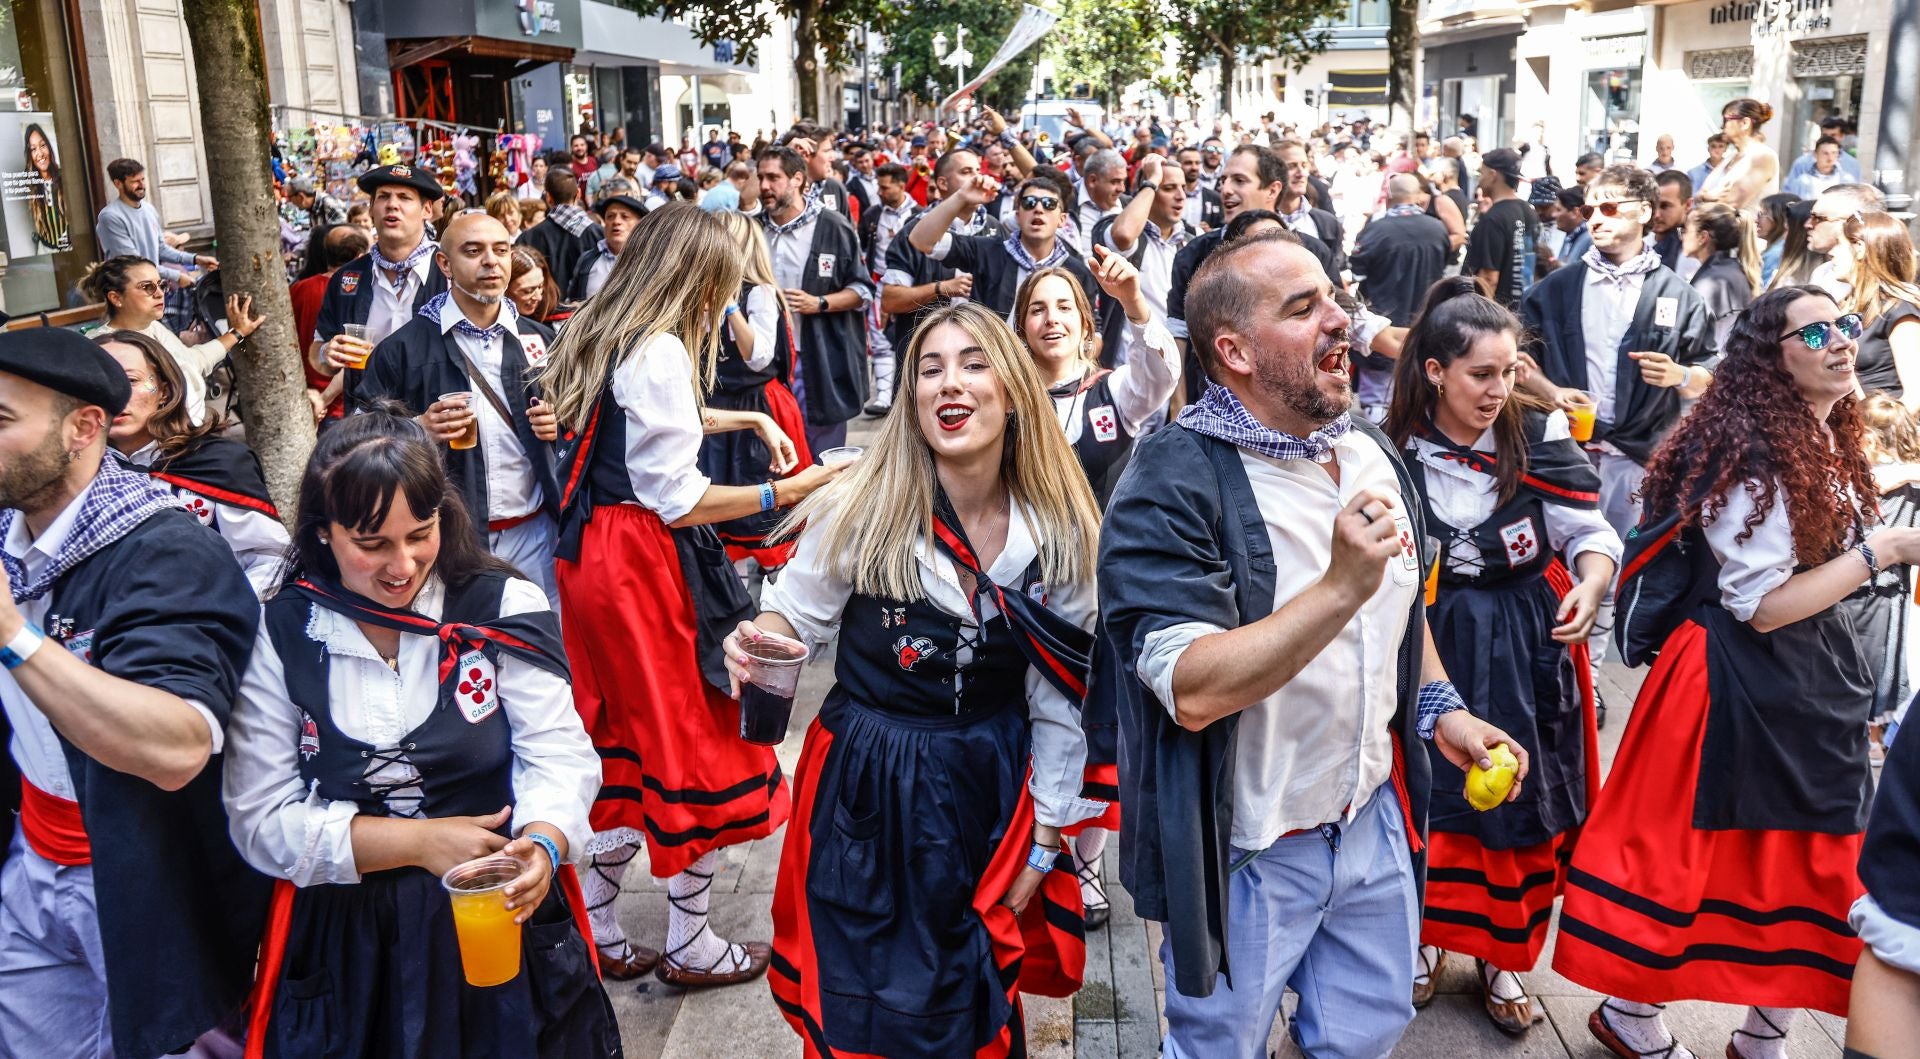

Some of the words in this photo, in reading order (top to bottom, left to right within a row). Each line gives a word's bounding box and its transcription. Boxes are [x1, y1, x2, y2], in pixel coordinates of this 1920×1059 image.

[536, 109, 553, 123] BBVA
[12, 171, 28, 179] puerta
[28, 170, 39, 178] para
[460, 653, 485, 669] TASUNA
[472, 700, 495, 718] GASTEIZ
